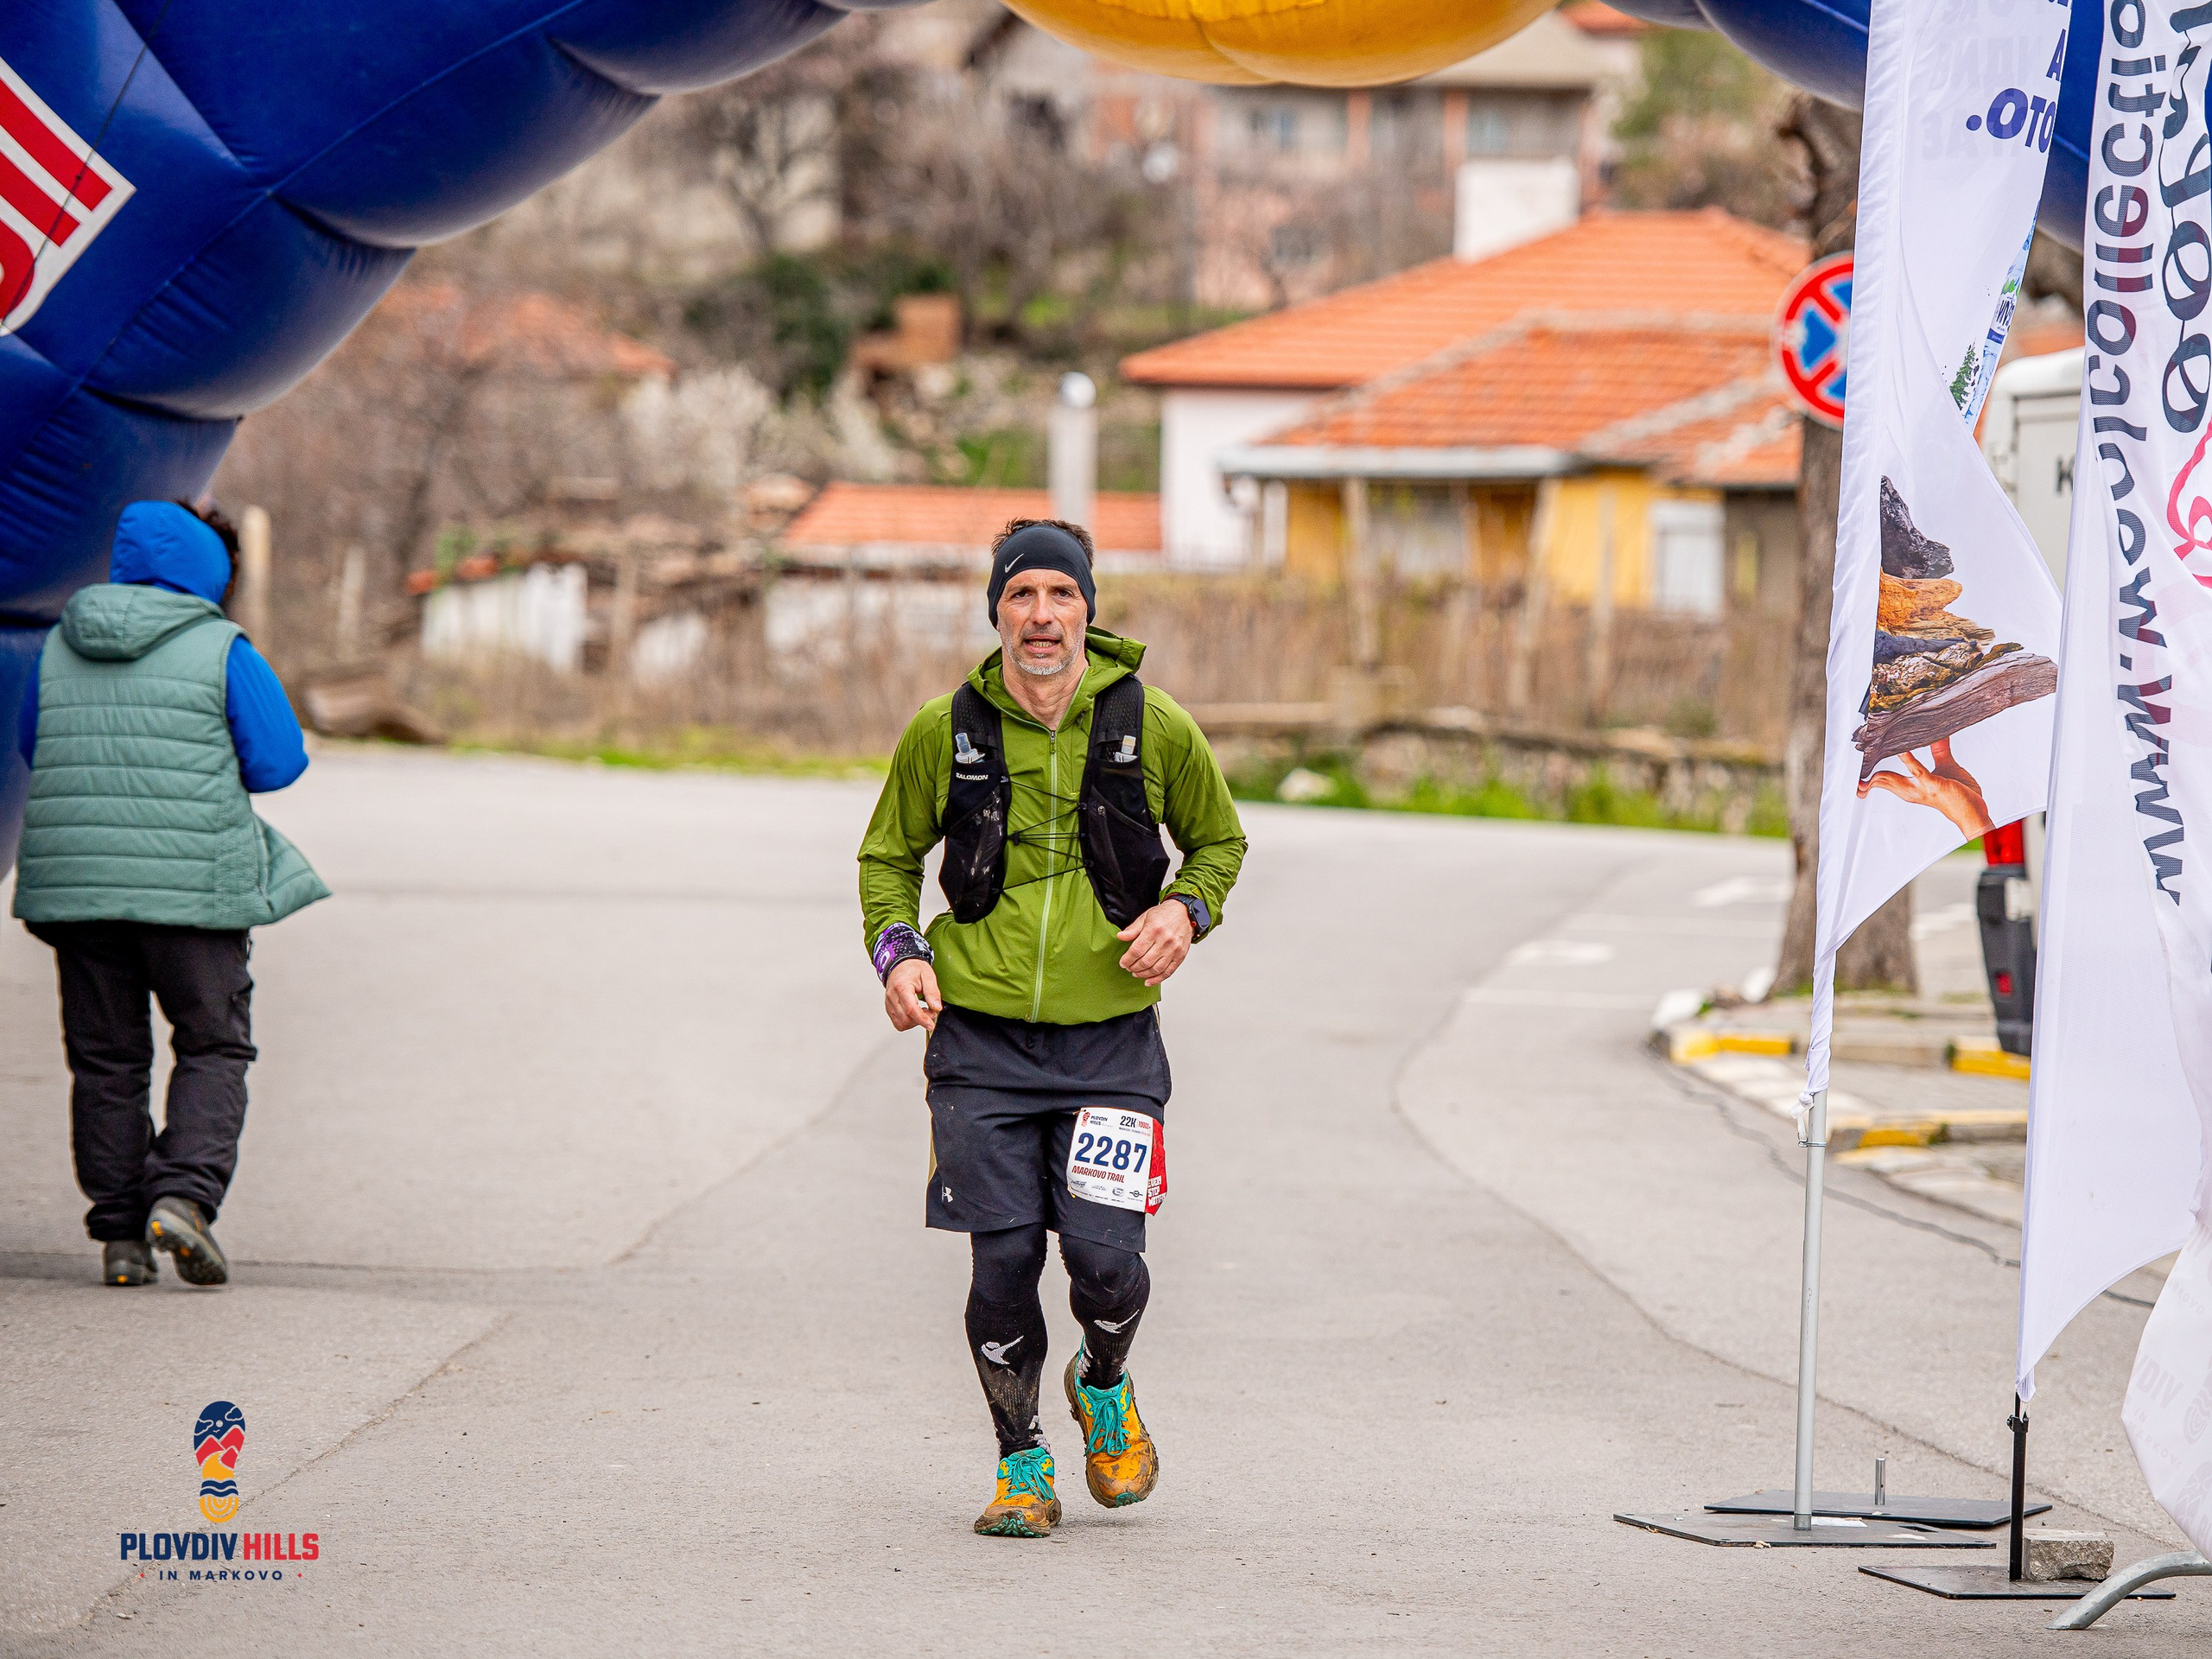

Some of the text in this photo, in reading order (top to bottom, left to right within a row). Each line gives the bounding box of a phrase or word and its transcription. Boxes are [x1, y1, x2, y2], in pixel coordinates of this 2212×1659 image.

[956, 772, 988, 781] SALOMON
[1119, 1116, 1137, 1128] 22K
[1074, 1132, 1147, 1173] 2287
[1071, 1165, 1125, 1184] MARKOVO TRAIL
